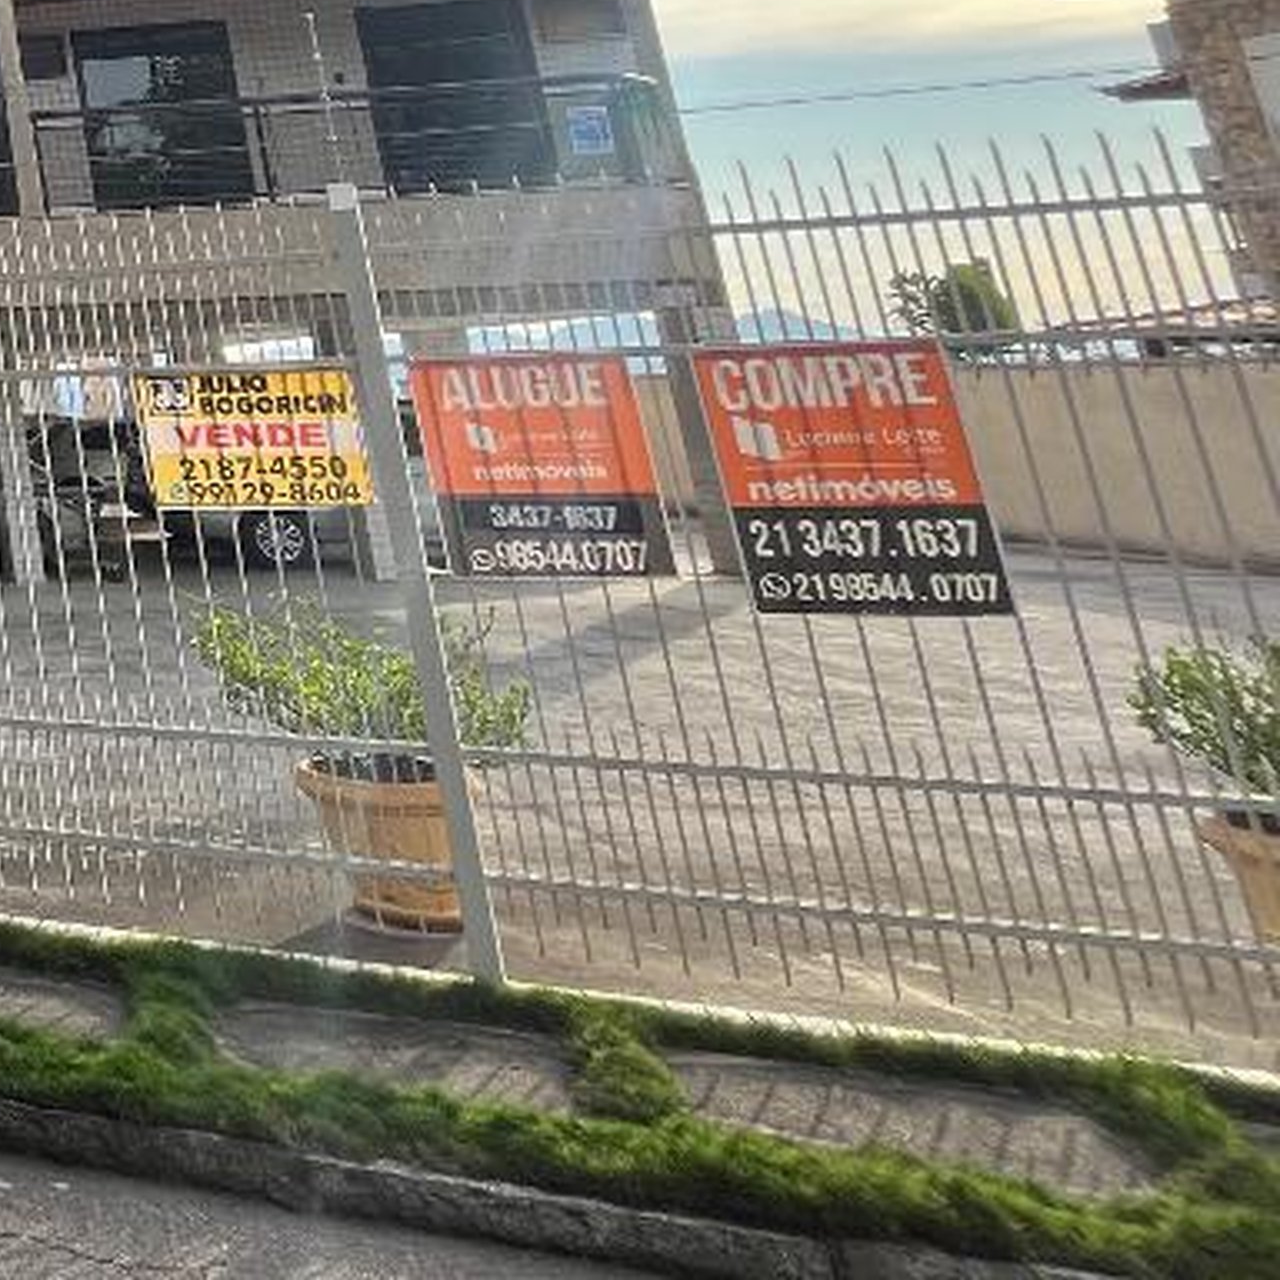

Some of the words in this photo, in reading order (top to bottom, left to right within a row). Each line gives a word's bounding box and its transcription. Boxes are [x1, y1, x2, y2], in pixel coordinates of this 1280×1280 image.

[443, 362, 607, 411] ALUGUE
[712, 352, 937, 411] COMPRE
[175, 422, 327, 448] VENDE
[749, 519, 790, 557] 21
[798, 518, 978, 557] 3437.1637
